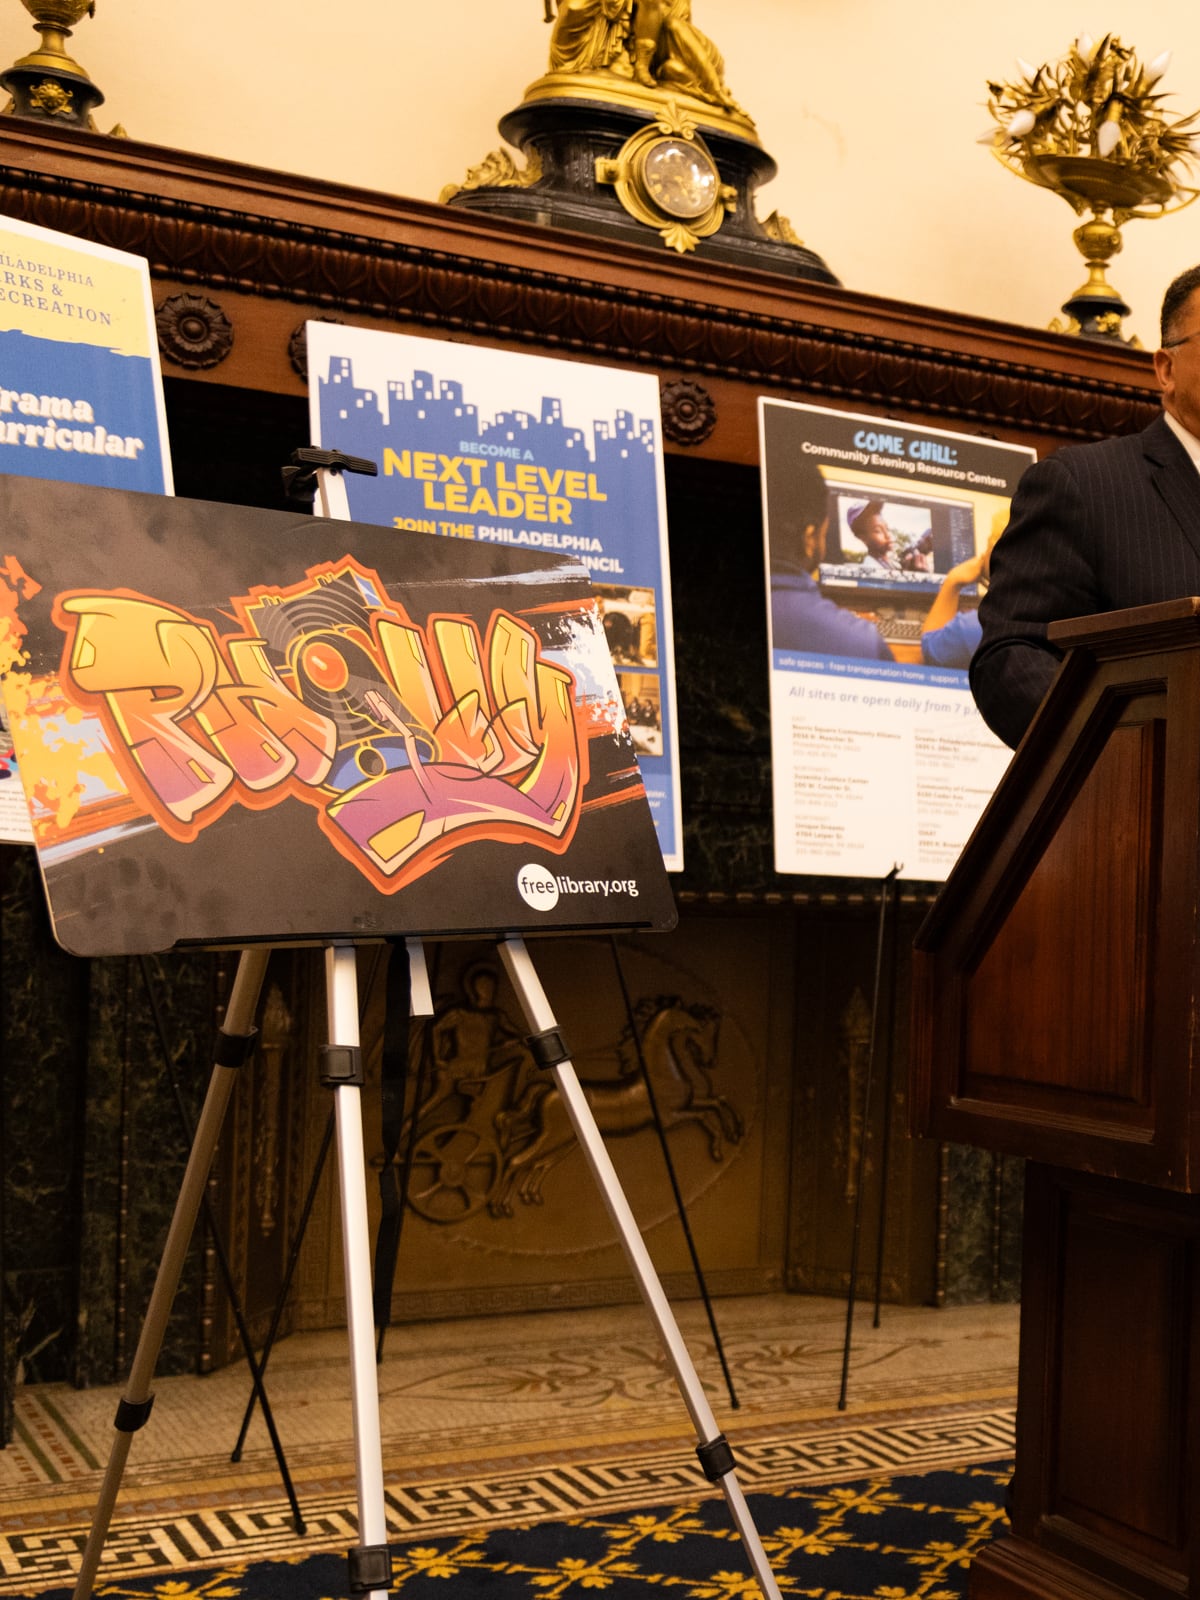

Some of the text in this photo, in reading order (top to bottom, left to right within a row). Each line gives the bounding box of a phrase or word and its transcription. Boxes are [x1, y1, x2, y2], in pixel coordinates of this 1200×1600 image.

[0, 253, 94, 287] ILADELPHIA
[0, 270, 63, 297] RKS &
[0, 287, 112, 326] ECREATION
[0, 386, 95, 423] rama
[0, 418, 145, 460] rricular
[459, 440, 534, 462] BECOME A
[854, 431, 905, 456] COME
[383, 448, 607, 502] NEXT LEVEL
[802, 442, 1007, 488] Community Evening Resource Centers
[423, 482, 573, 525] LEADER
[393, 517, 603, 553] JOIN THE PHILADELPHIA
[789, 686, 805, 697] All
[808, 688, 836, 701] sites
[840, 693, 859, 703] are
[862, 694, 891, 708] open
[894, 695, 923, 713] daily
[923, 698, 951, 714] from
[955, 703, 962, 713] 7
